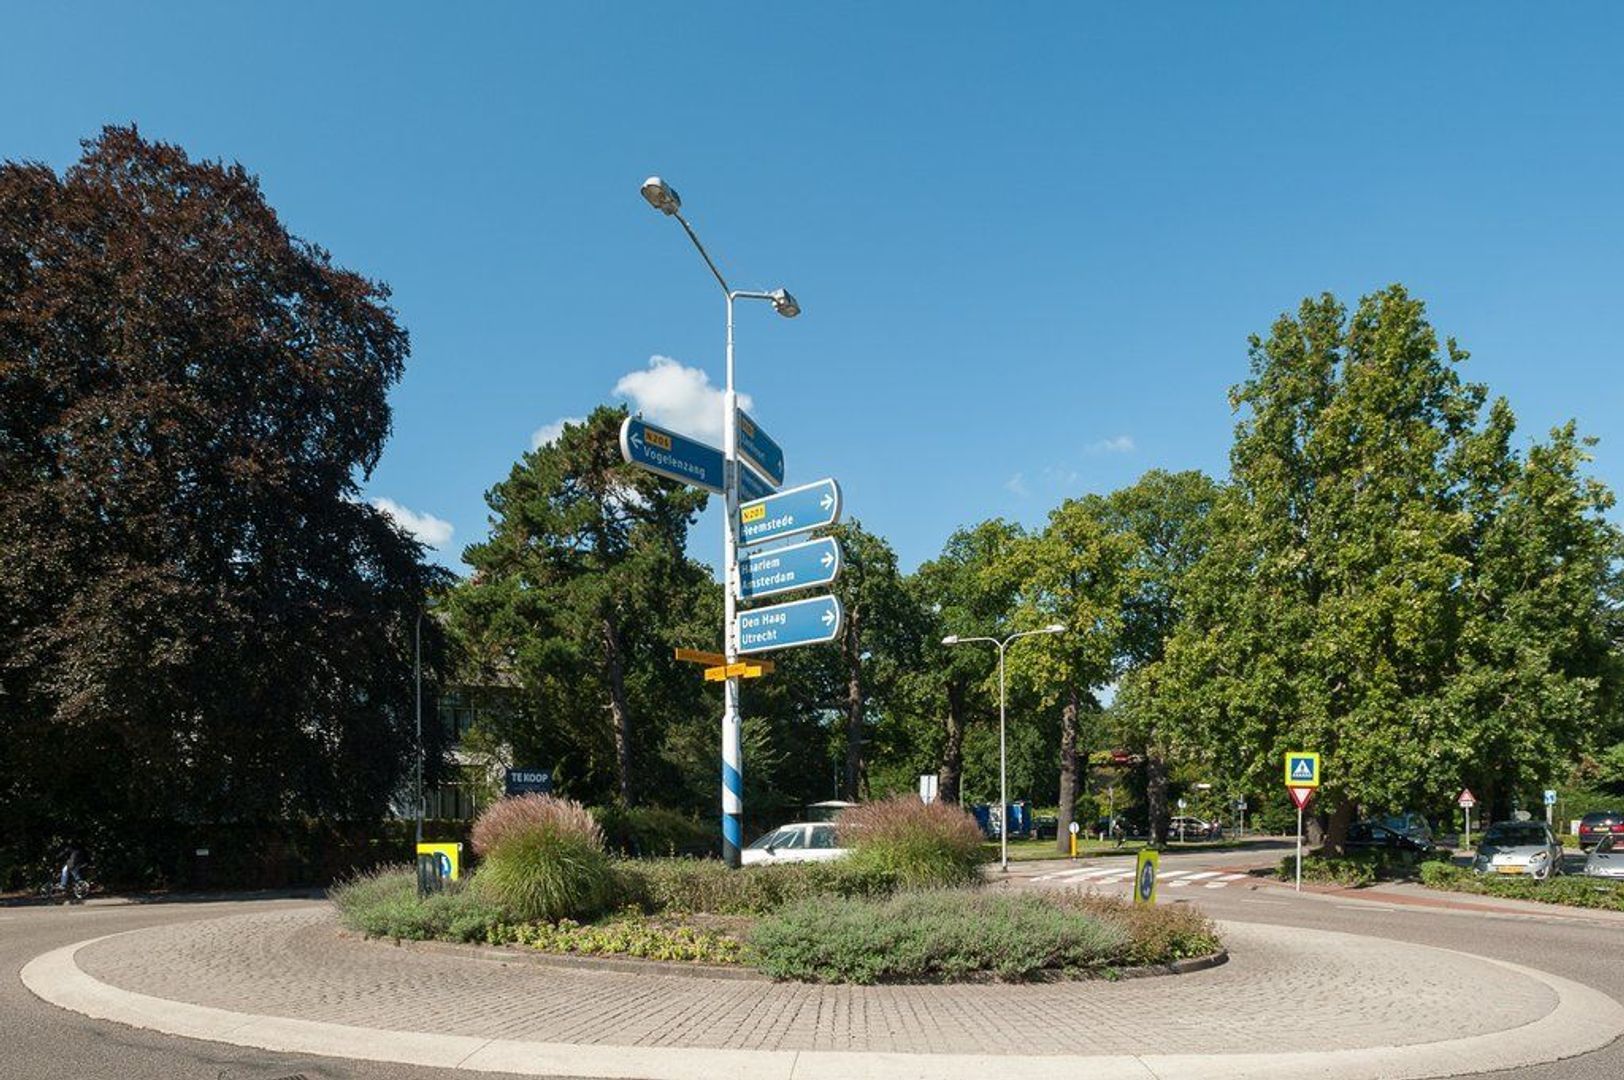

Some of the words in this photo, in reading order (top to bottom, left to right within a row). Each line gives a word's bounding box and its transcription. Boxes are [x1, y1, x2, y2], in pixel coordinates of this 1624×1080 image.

[643, 445, 706, 480] Vogelenzang
[743, 514, 794, 536] Heemstede
[741, 558, 780, 575] Haarlem
[742, 571, 795, 590] Amsterdam
[742, 617, 760, 629] Den
[762, 613, 787, 625] Haag
[742, 629, 778, 645] Utrecht
[511, 772, 523, 783] TE
[523, 772, 549, 783] KOOP
